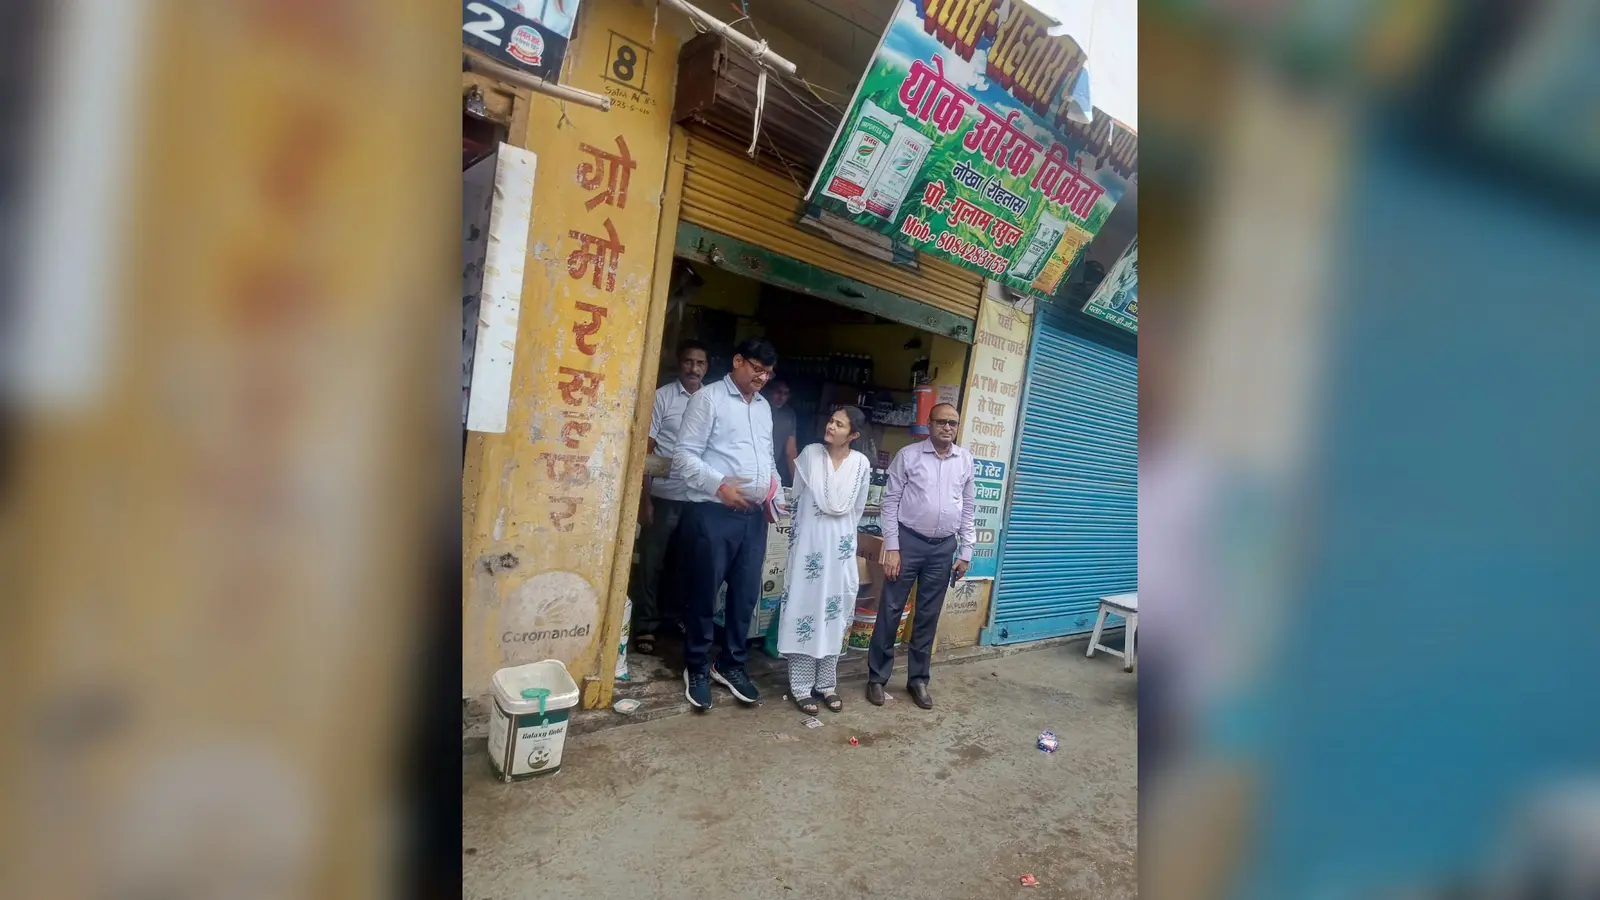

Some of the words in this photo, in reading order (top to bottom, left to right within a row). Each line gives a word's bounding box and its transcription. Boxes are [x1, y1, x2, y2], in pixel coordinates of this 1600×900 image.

[463, 2, 505, 46] 2
[613, 45, 637, 81] 8
[899, 54, 976, 134] थोक
[963, 104, 1044, 177] उर्वरक
[1029, 141, 1106, 219] विक्रेता
[952, 161, 985, 190] नोखा
[980, 175, 1030, 219] (रोहतास)
[947, 197, 995, 232] गुलाम
[990, 218, 1025, 247] रसुल
[936, 231, 1009, 274] 8084283755
[978, 330, 1006, 351] आधार
[1006, 339, 1025, 357] कार्ड
[991, 356, 1008, 373] एवं
[971, 373, 998, 394] ATM
[1000, 379, 1020, 398] कार्ड
[977, 395, 987, 414] से
[969, 439, 989, 457] होता
[974, 483, 1000, 499] नेशन
[979, 532, 993, 540] ID
[502, 624, 590, 643] Coromandel
